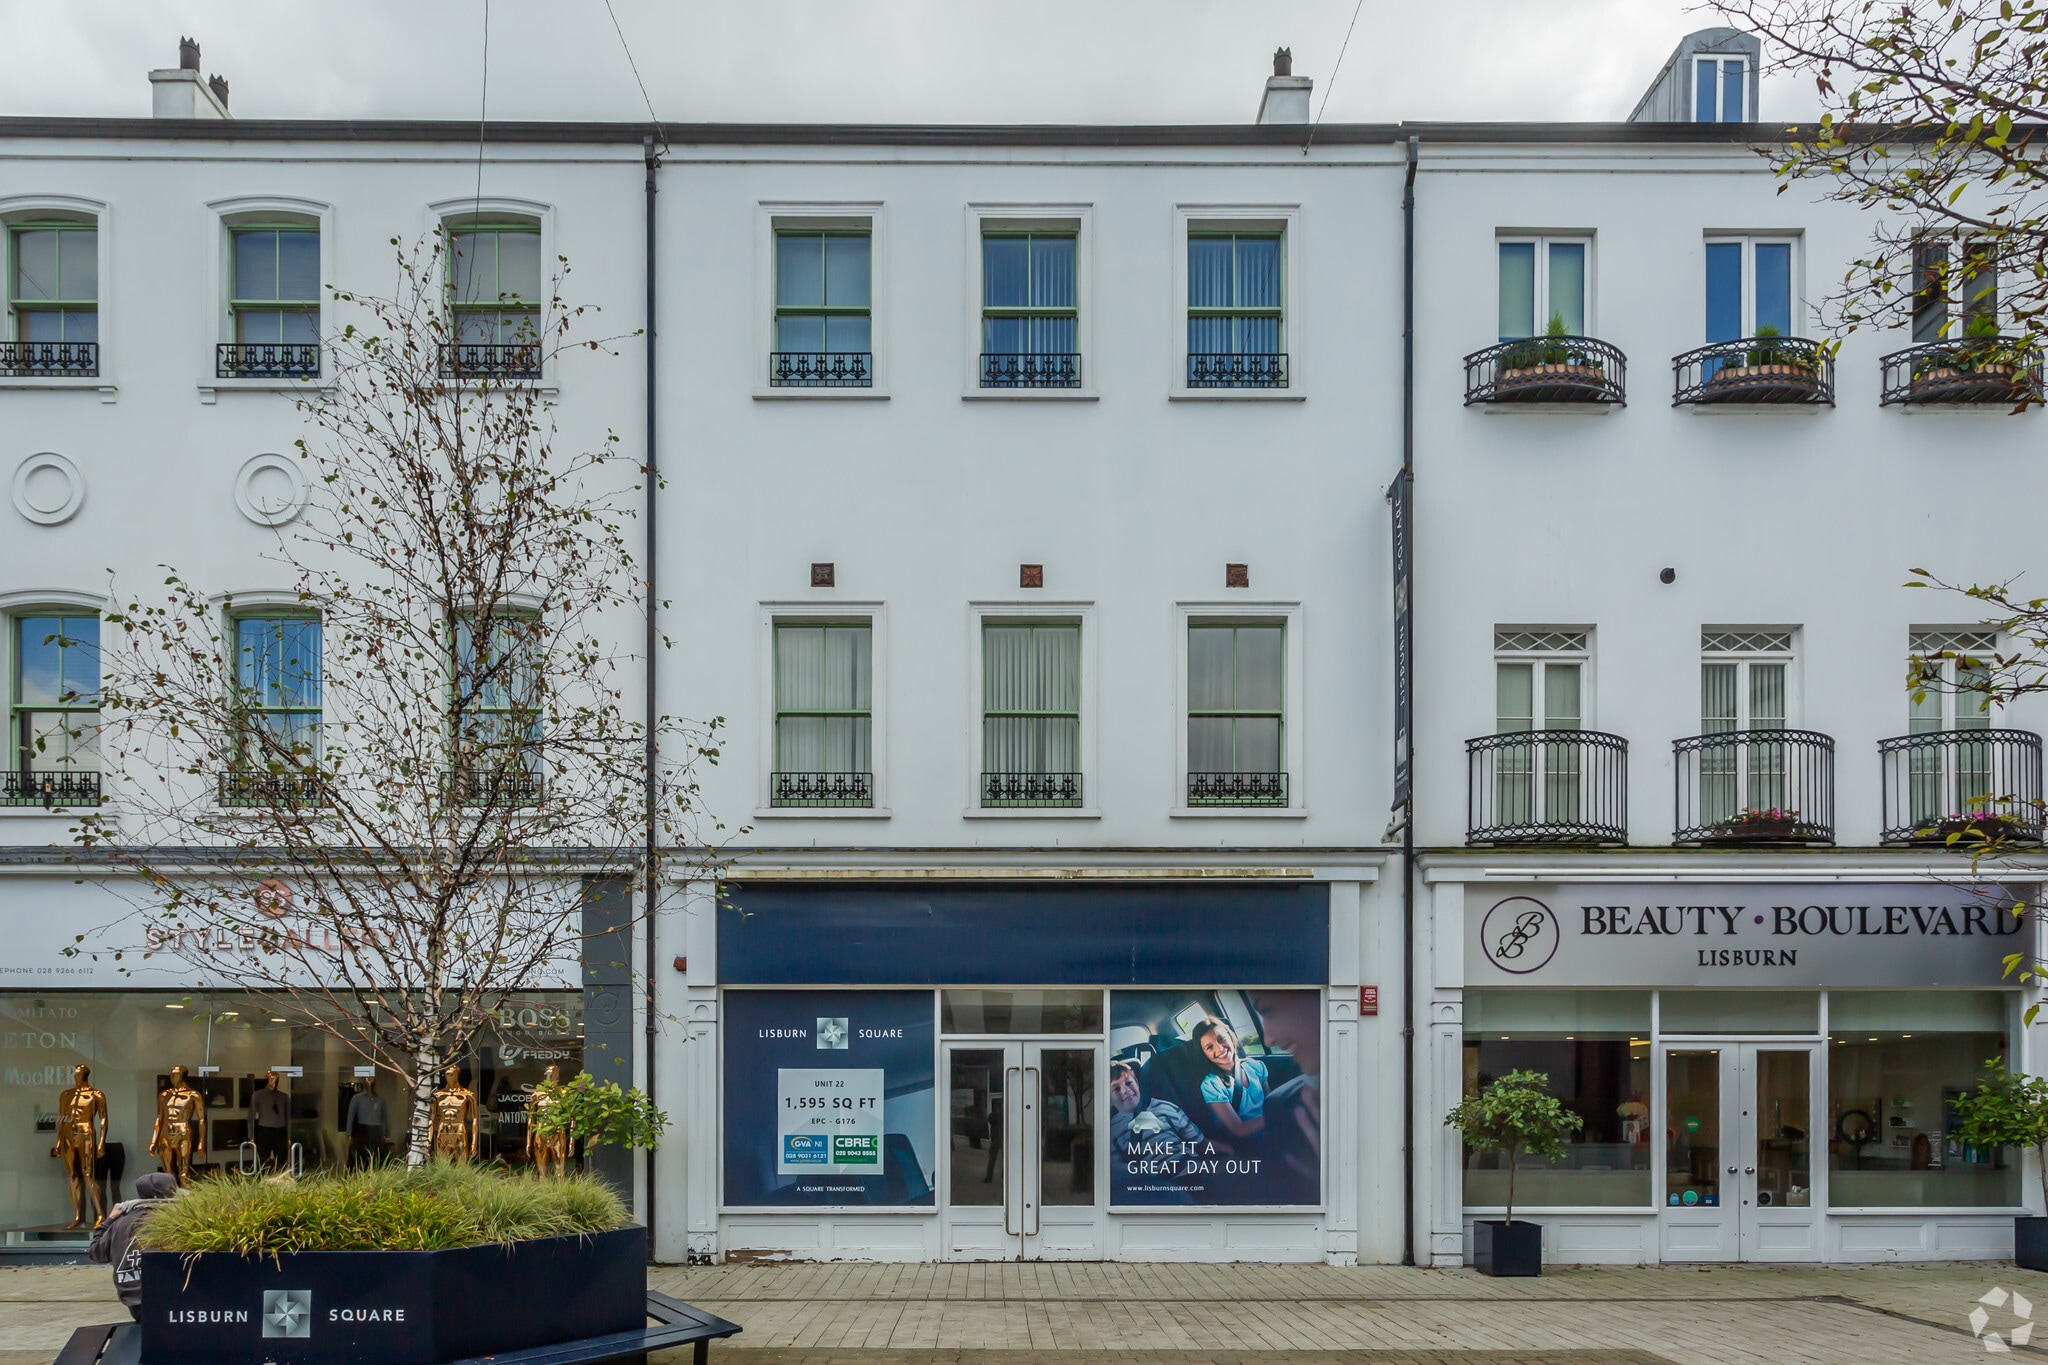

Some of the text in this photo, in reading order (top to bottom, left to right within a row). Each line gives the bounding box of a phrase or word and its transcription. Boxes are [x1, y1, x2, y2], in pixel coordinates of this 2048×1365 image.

[1580, 905, 2024, 936] BEAUTY BOULEVARD
[1697, 949, 1798, 967] LISBURN
[498, 1008, 571, 1029] BOSS
[4, 1032, 76, 1049] ETON
[759, 1029, 903, 1038] LISBURN SQUARE
[785, 1097, 876, 1110] 1,595 SQ FT
[498, 1111, 527, 1123] ANTON
[835, 1138, 870, 1147] CBRE
[1127, 1141, 1216, 1155] MAKE IT A
[1127, 1160, 1262, 1174] GREAT DAY OUT
[169, 1309, 405, 1323] LISBURN SQUARE
